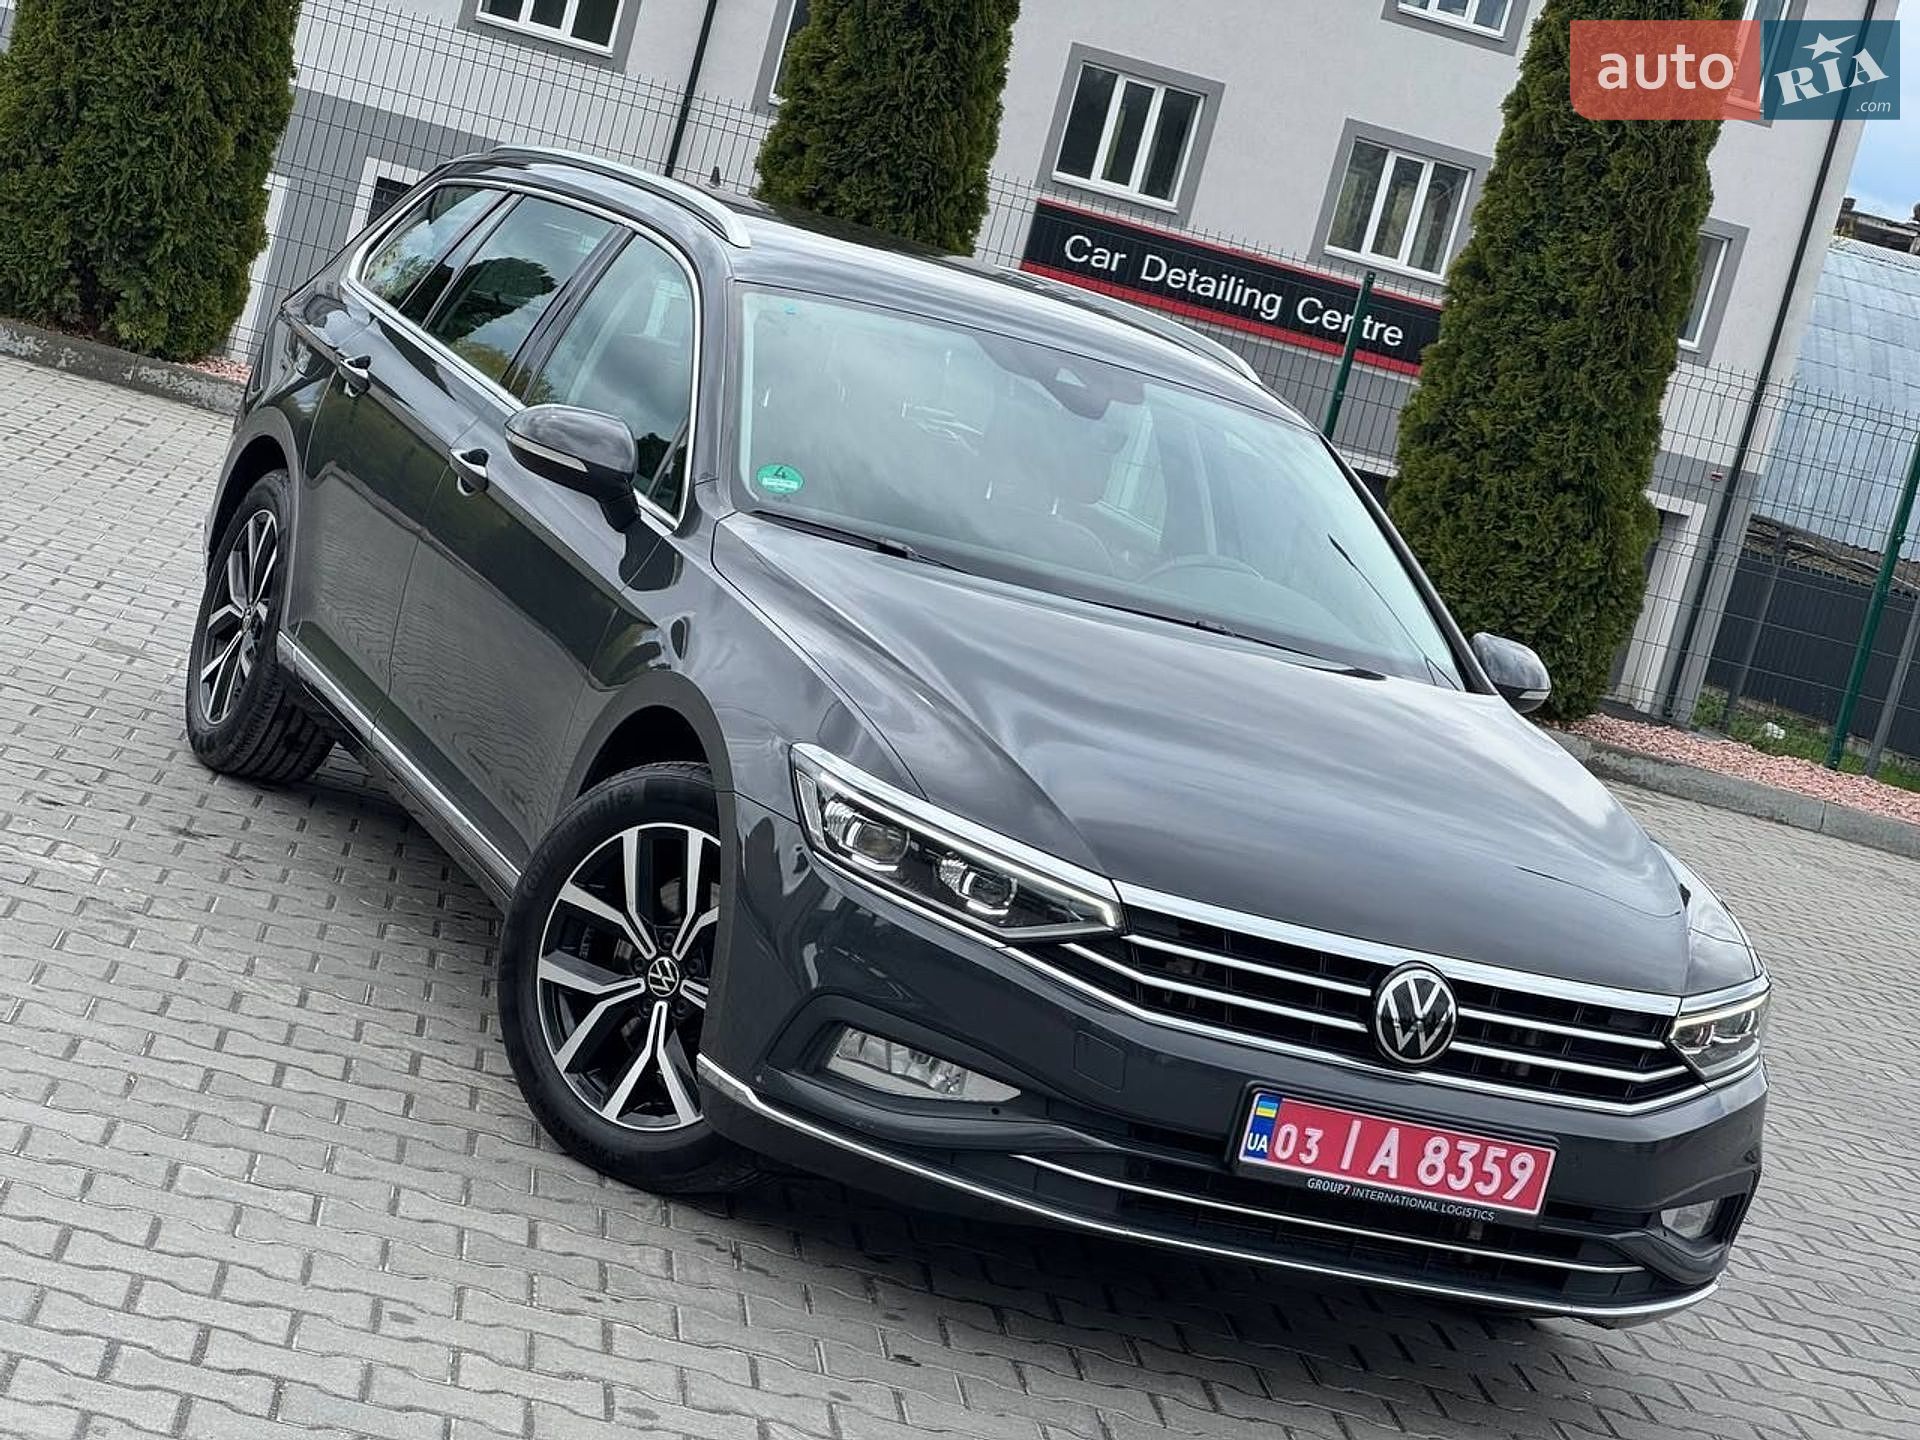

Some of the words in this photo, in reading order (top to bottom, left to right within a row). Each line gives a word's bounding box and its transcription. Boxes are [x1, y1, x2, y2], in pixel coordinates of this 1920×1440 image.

[1064, 234, 1127, 273] Car
[1141, 253, 1283, 321] Detailing
[774, 466, 787, 479] 4
[1247, 1132, 1268, 1153] UA
[1273, 1123, 1324, 1164] 03
[1417, 1136, 1536, 1201] 8359
[1307, 1177, 1350, 1196] GROUP7
[1351, 1187, 1439, 1213] INTERNATIONAL
[1441, 1205, 1496, 1222] LOGISTICS
